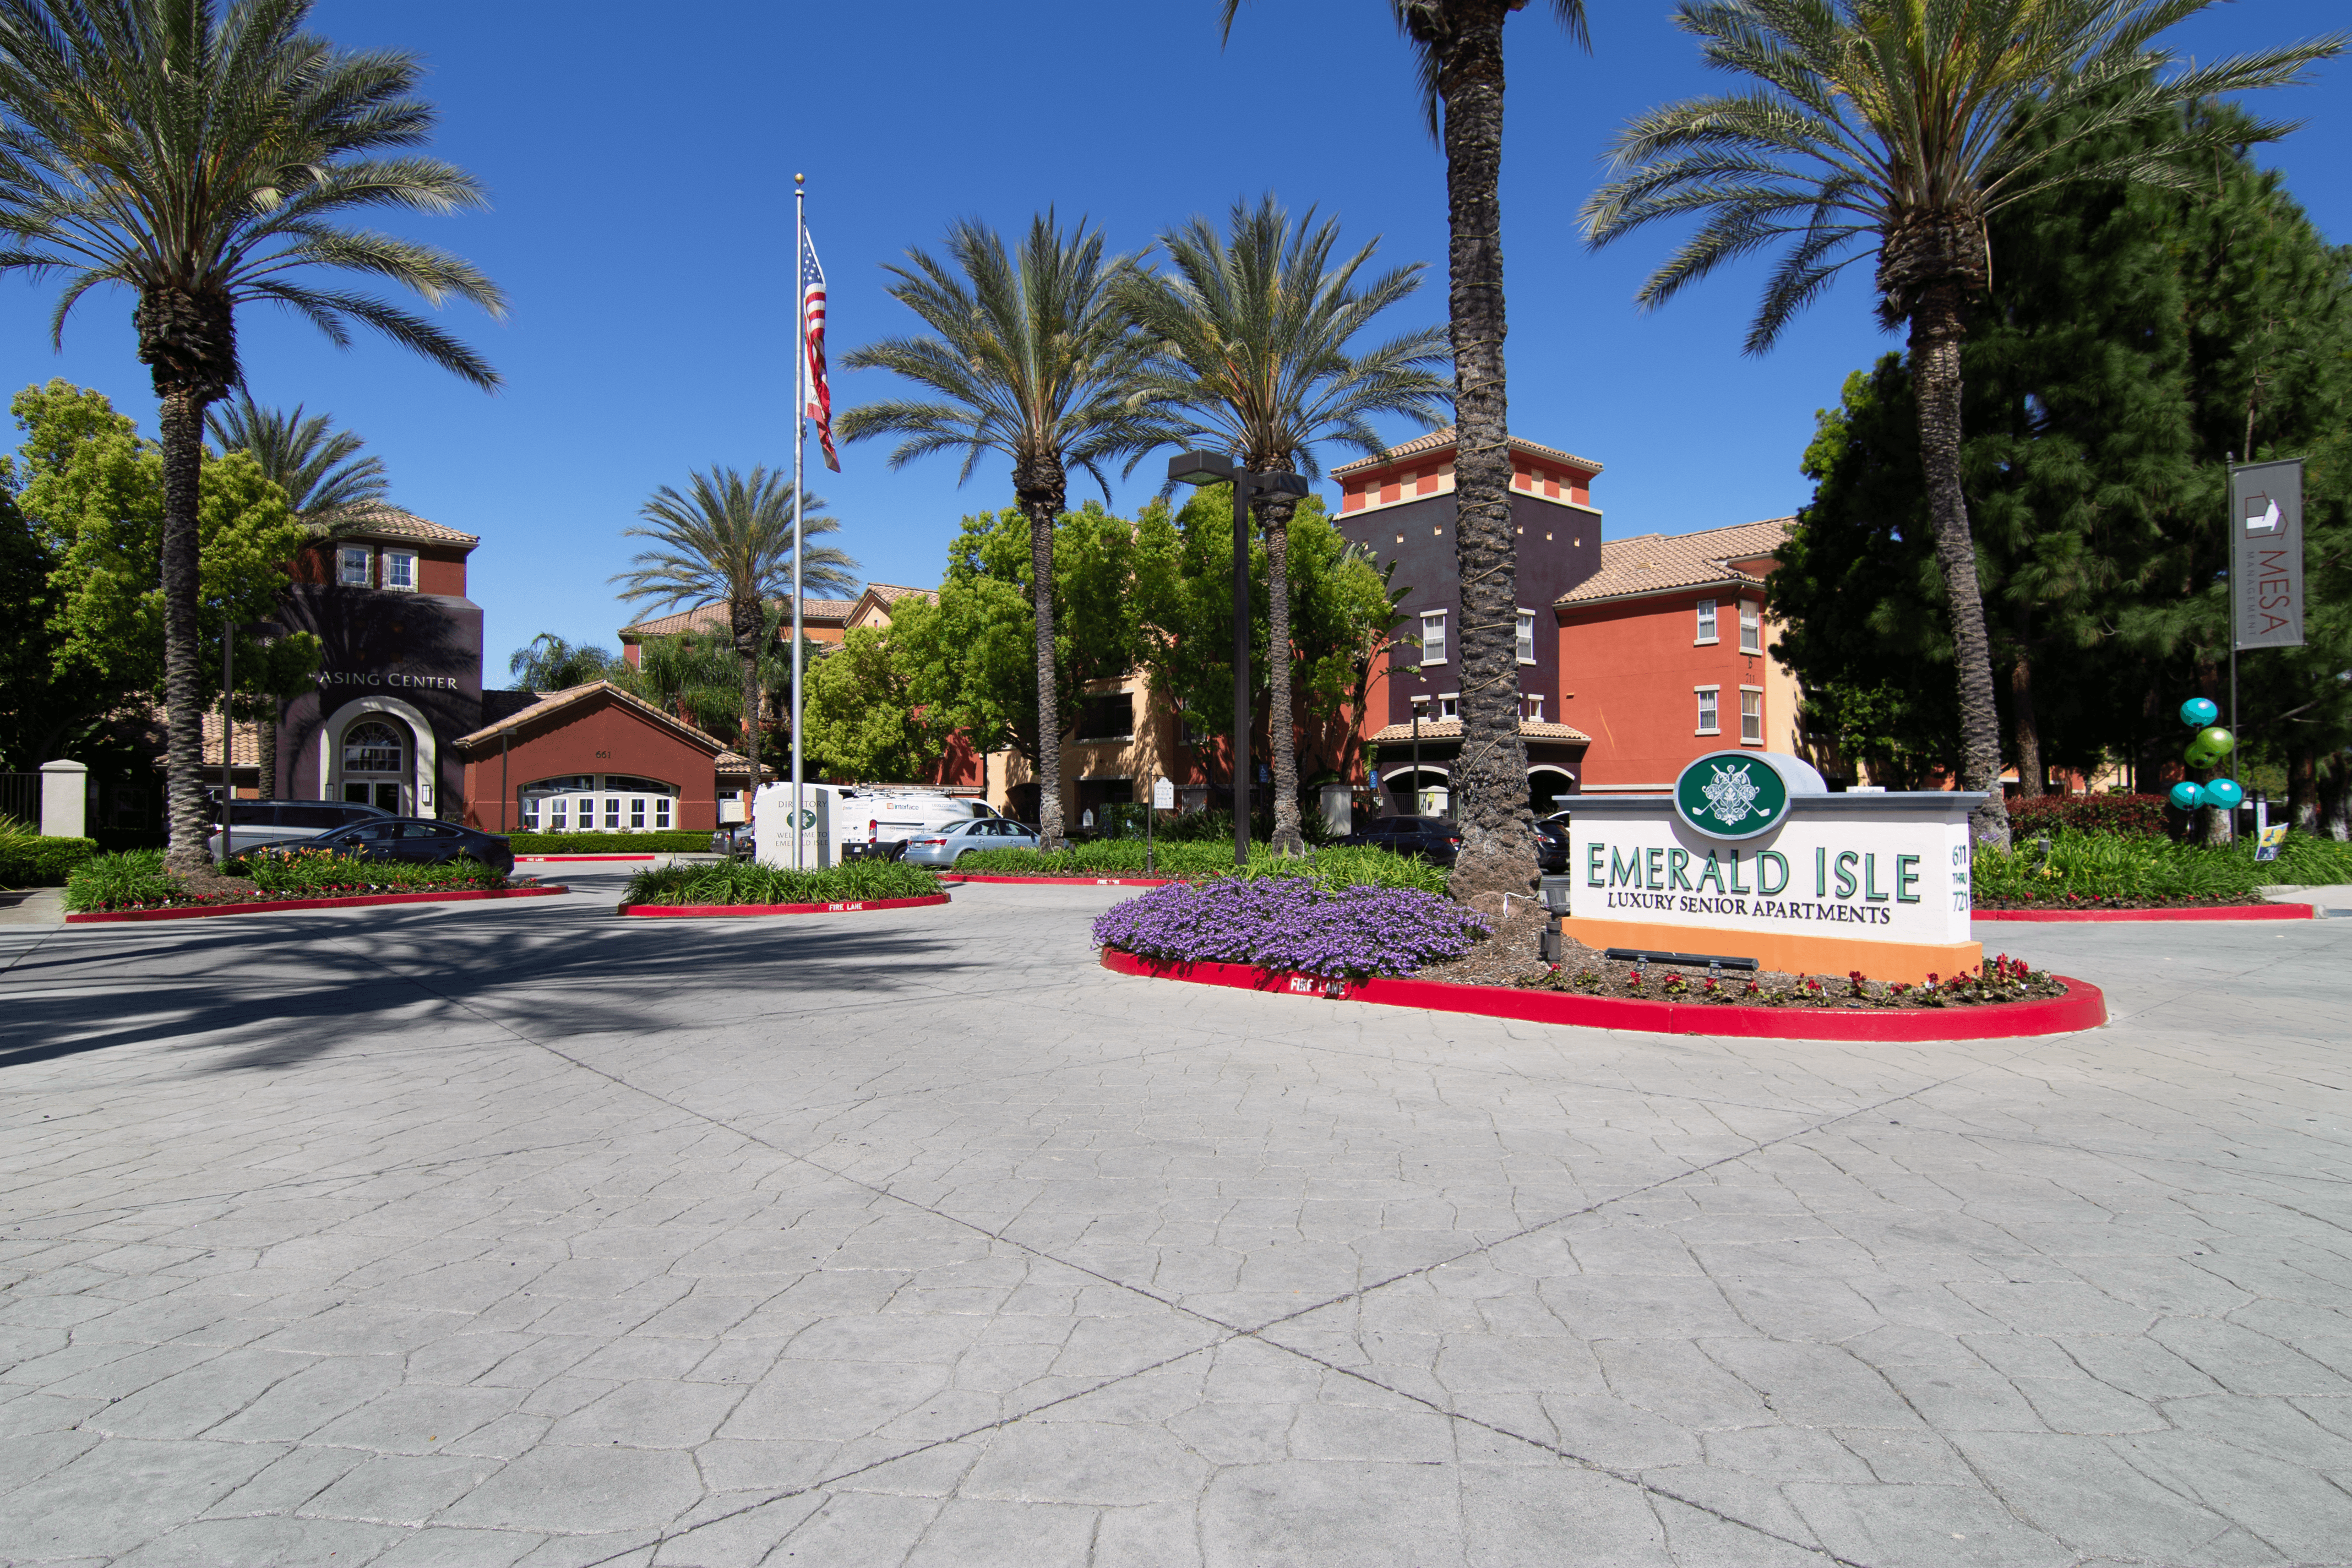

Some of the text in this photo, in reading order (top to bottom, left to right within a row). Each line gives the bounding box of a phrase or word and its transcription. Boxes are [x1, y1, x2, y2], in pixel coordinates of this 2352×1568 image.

[2246, 551, 2256, 635] MANAGEMENT
[2258, 551, 2291, 635] MESA
[1748, 656, 1753, 669] B
[308, 671, 458, 689] ASING CENTER
[1745, 673, 1755, 683] 711
[596, 750, 611, 759] 661
[1952, 845, 1966, 866] 611
[1588, 843, 1920, 903] EMERALD ISLE
[1952, 872, 1967, 885] THRU
[1608, 892, 1890, 924] LUXURY SENIOR APARTMENTS
[1952, 890, 1968, 912] 721
[1319, 981, 1345, 995] LANE
